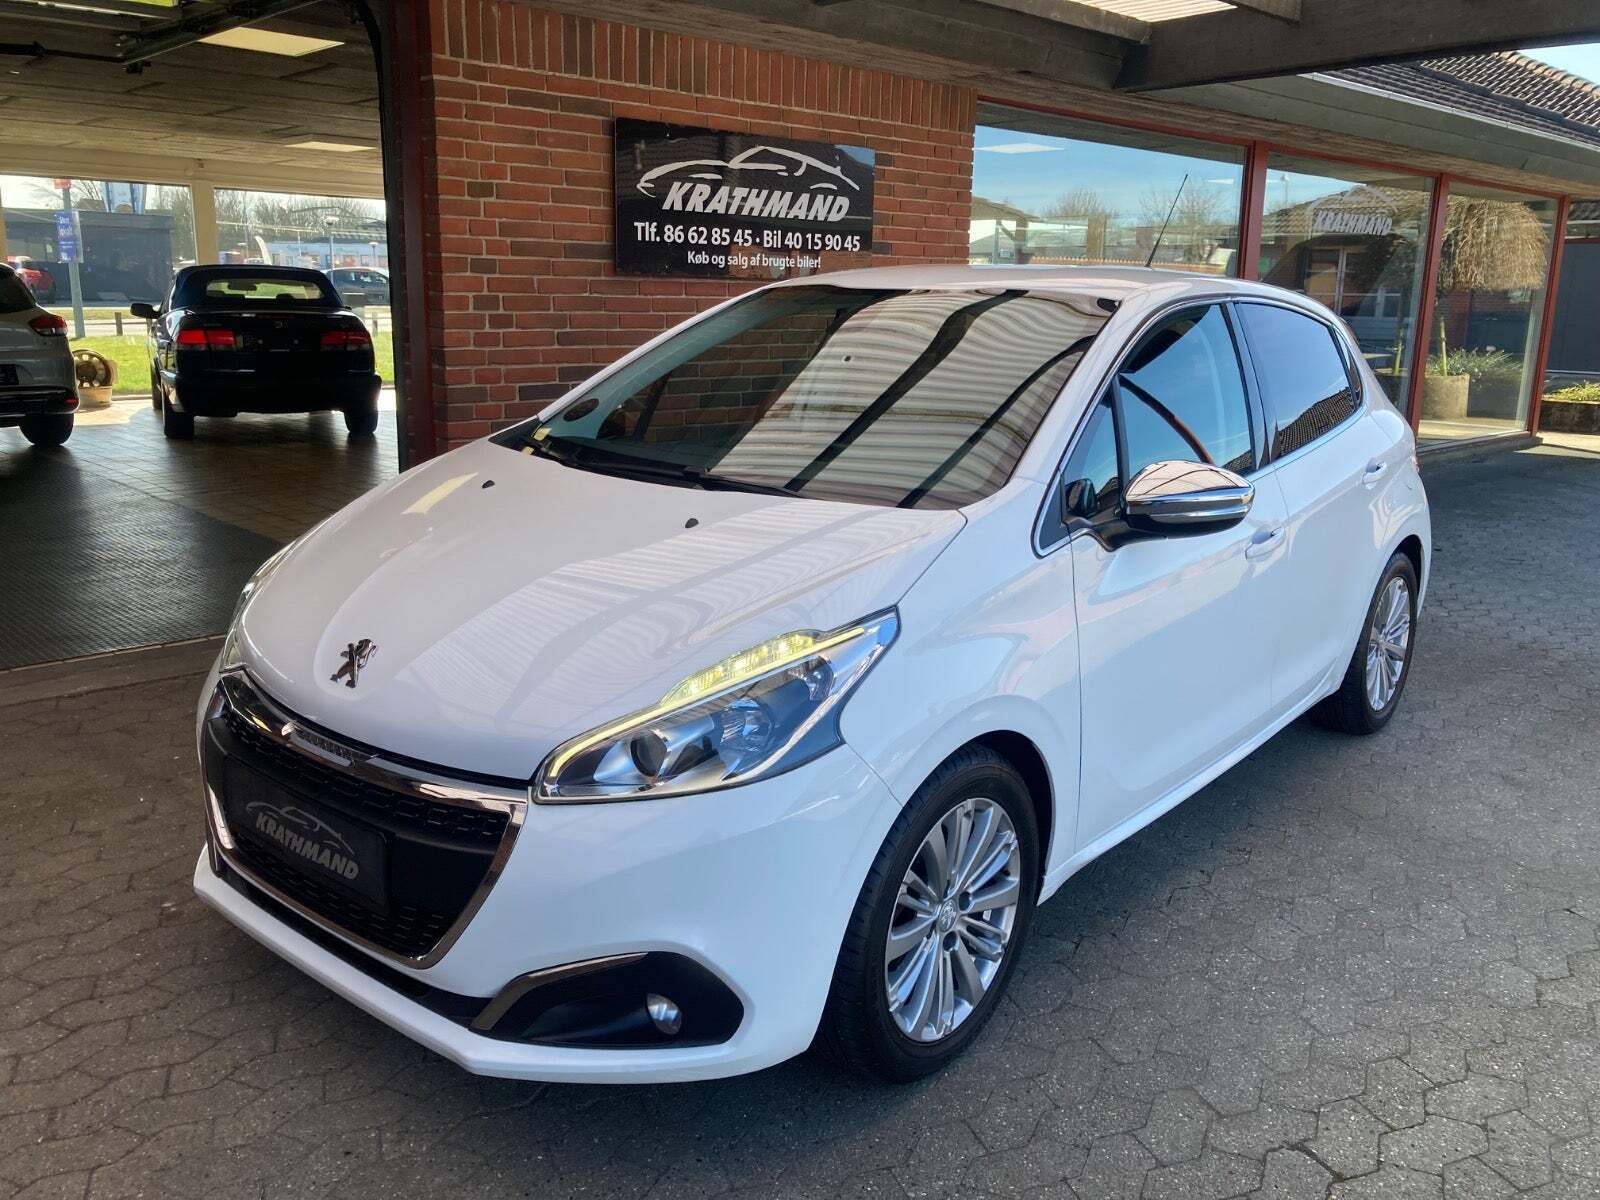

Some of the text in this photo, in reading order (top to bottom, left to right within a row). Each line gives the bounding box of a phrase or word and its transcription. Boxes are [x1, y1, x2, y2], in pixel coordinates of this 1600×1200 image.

[662, 181, 850, 222] KRATHMAND
[634, 221, 861, 252] Tlf. 86 62 85 45 Bil 40 15 90 45
[687, 251, 821, 270] Køb og salg af brugte biler!
[255, 813, 360, 881] KRATHMAND
